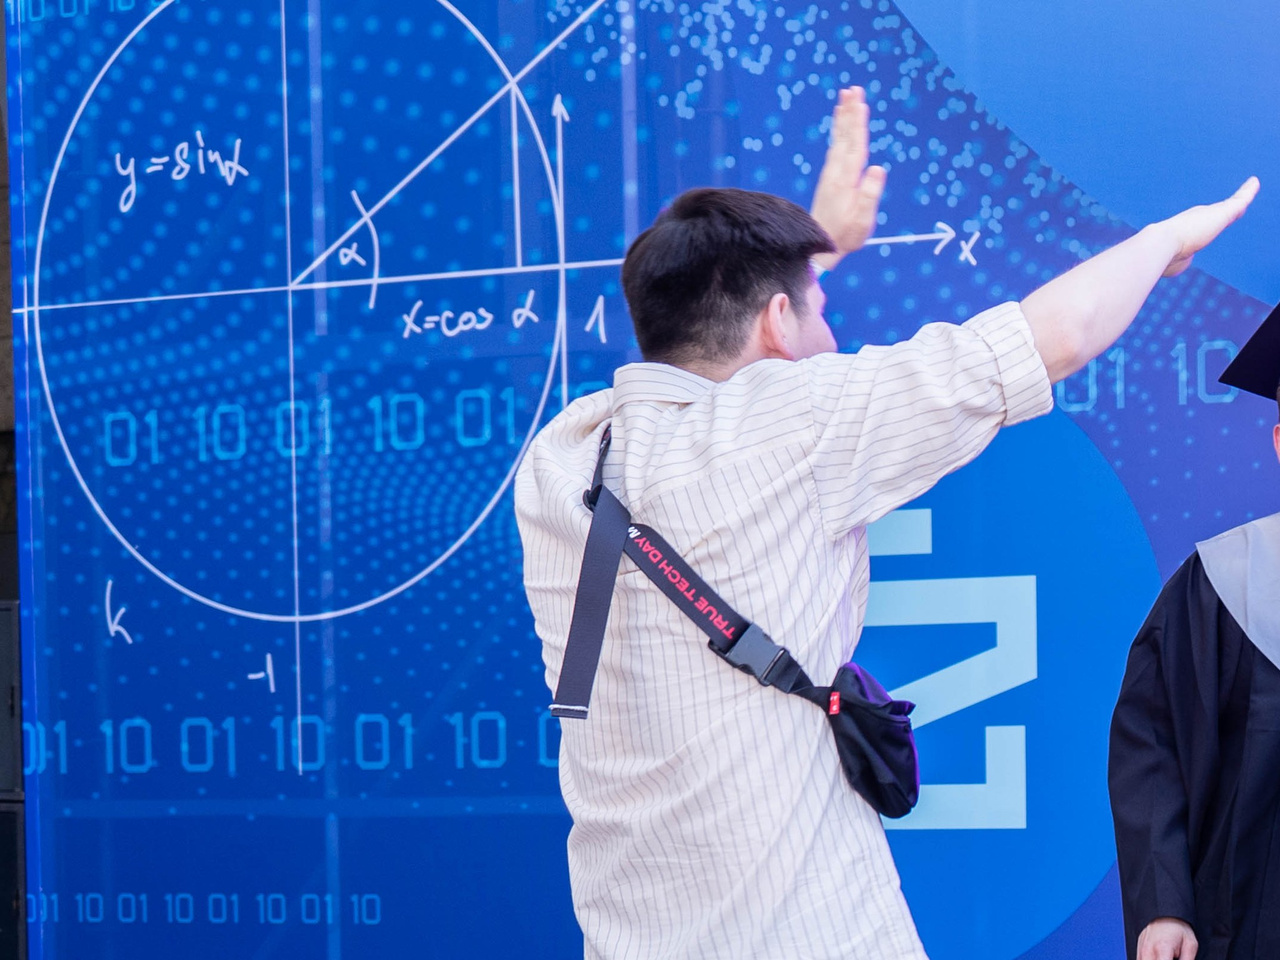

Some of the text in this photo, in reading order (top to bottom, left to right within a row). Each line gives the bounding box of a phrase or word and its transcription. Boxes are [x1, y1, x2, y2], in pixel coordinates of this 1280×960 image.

[104, 409, 158, 467] 01
[193, 404, 247, 461] 10
[275, 398, 331, 457] 01
[368, 392, 424, 452] 10
[456, 386, 517, 447] 01
[634, 537, 663, 564] DAY
[658, 559, 696, 601] TECH
[694, 596, 735, 639] TRUE
[100, 719, 152, 774] 10
[180, 716, 236, 773] 01
[270, 714, 325, 771] 10
[355, 712, 413, 770] 01
[448, 711, 507, 769] 10
[75, 893, 104, 923] 10
[118, 893, 148, 923] 01
[164, 893, 194, 924] 10
[208, 893, 239, 924] 01
[256, 893, 286, 924] 10
[301, 893, 333, 924] 01
[350, 893, 382, 925] 10
